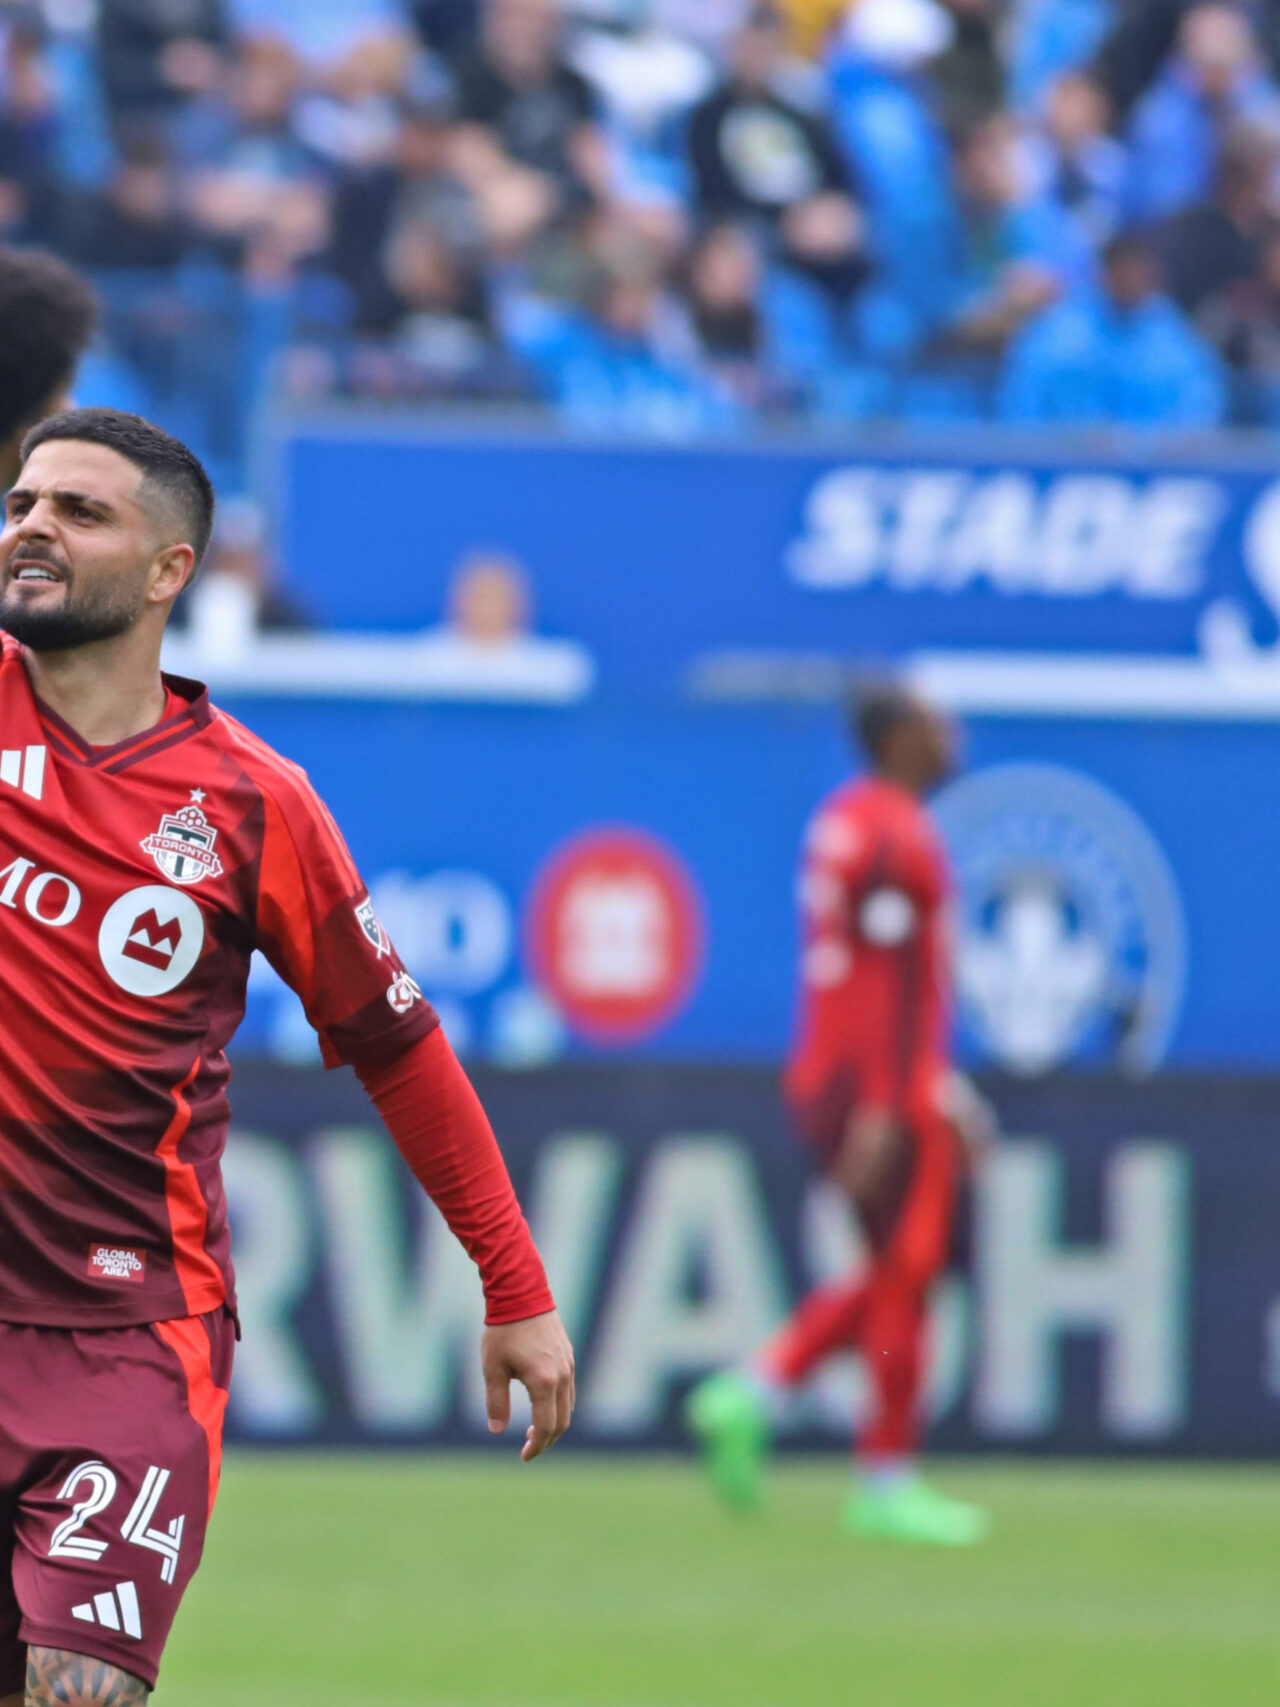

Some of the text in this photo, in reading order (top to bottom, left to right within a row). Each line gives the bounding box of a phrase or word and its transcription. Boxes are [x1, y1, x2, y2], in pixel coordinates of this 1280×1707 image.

[786, 466, 1224, 598] STADE
[153, 837, 212, 864] TORONTO
[92, 1256, 142, 1271] TORONTO
[96, 1247, 138, 1262] GLOBAL
[102, 1266, 131, 1278] AREA
[47, 1459, 186, 1585] 24
